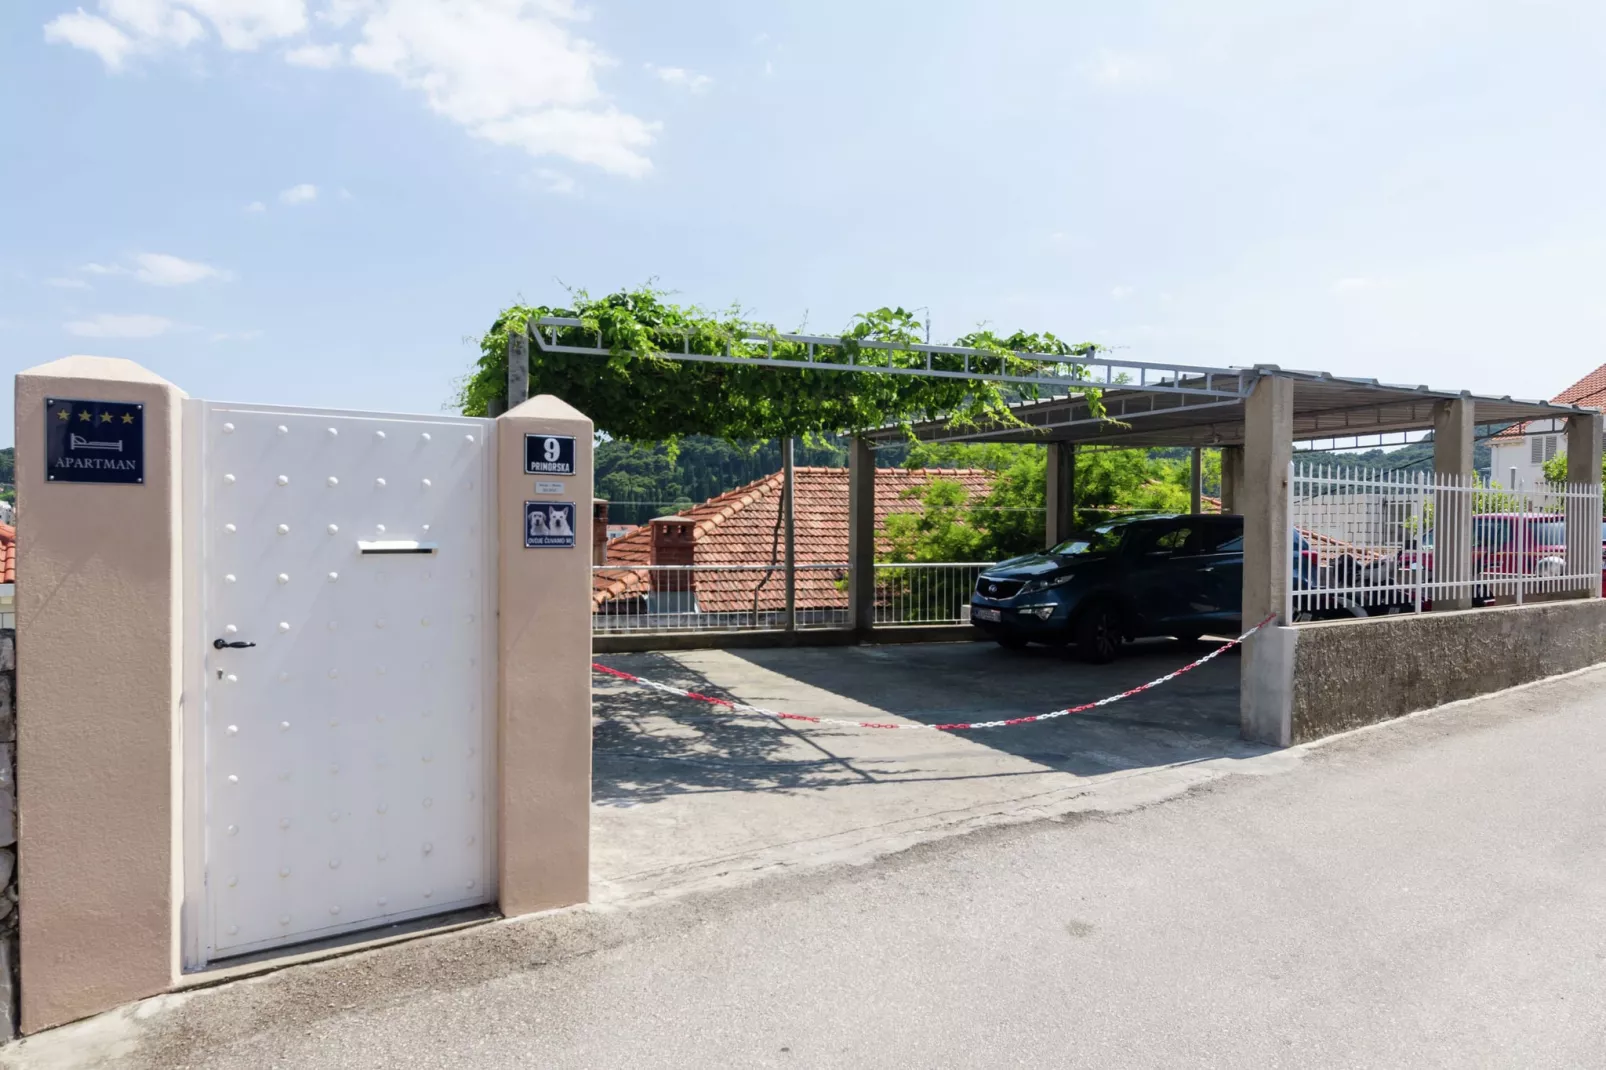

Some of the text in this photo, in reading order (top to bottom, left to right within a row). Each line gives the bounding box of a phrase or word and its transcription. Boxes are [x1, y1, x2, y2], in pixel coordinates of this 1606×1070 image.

[543, 437, 561, 462] 9
[55, 457, 136, 470] APARTMAN
[530, 461, 570, 472] PRIMORSKA
